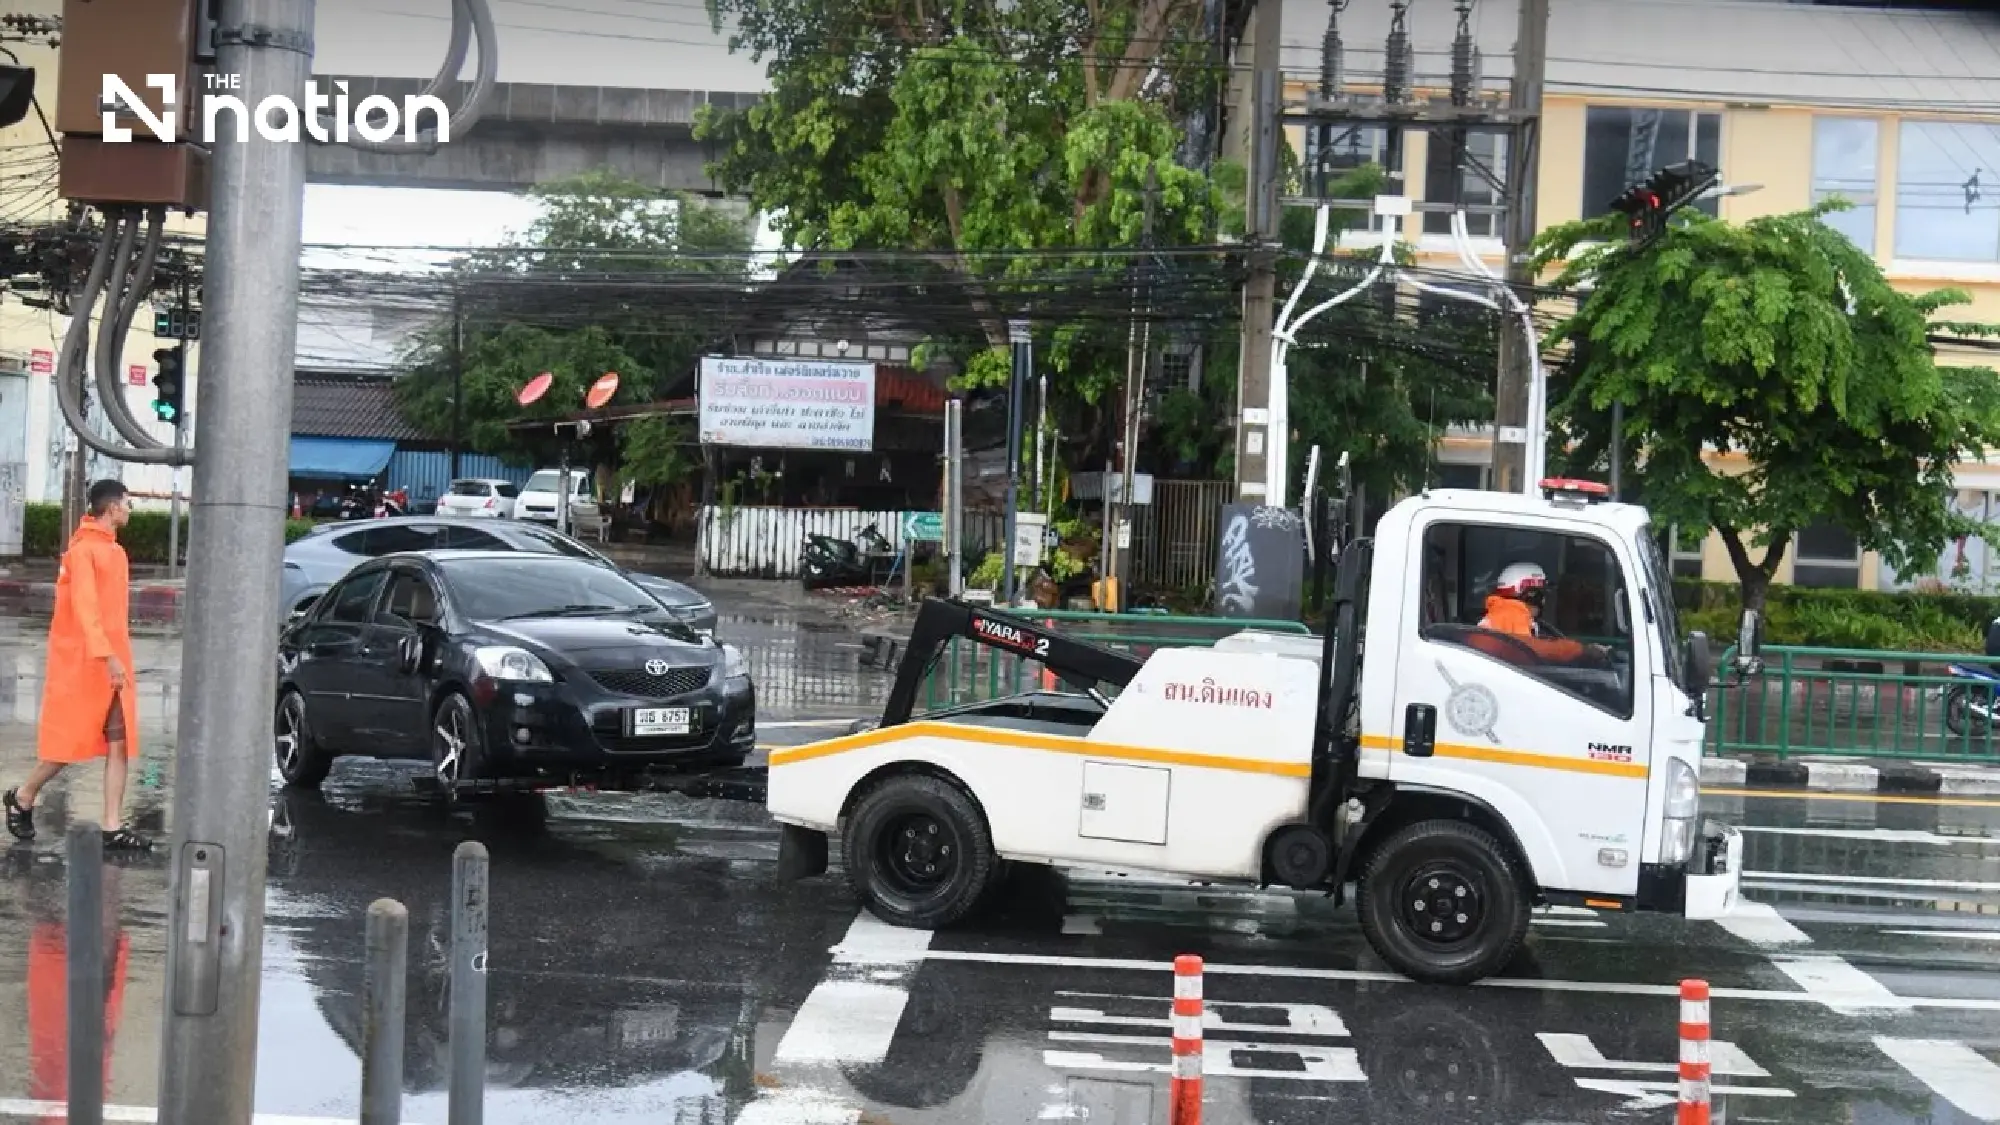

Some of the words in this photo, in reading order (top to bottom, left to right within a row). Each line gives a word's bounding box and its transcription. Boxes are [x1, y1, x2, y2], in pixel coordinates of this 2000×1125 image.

[1035, 638, 1050, 656] 2
[1165, 676, 1272, 709] สน.ดินแดง
[1588, 742, 1632, 754] NMR
